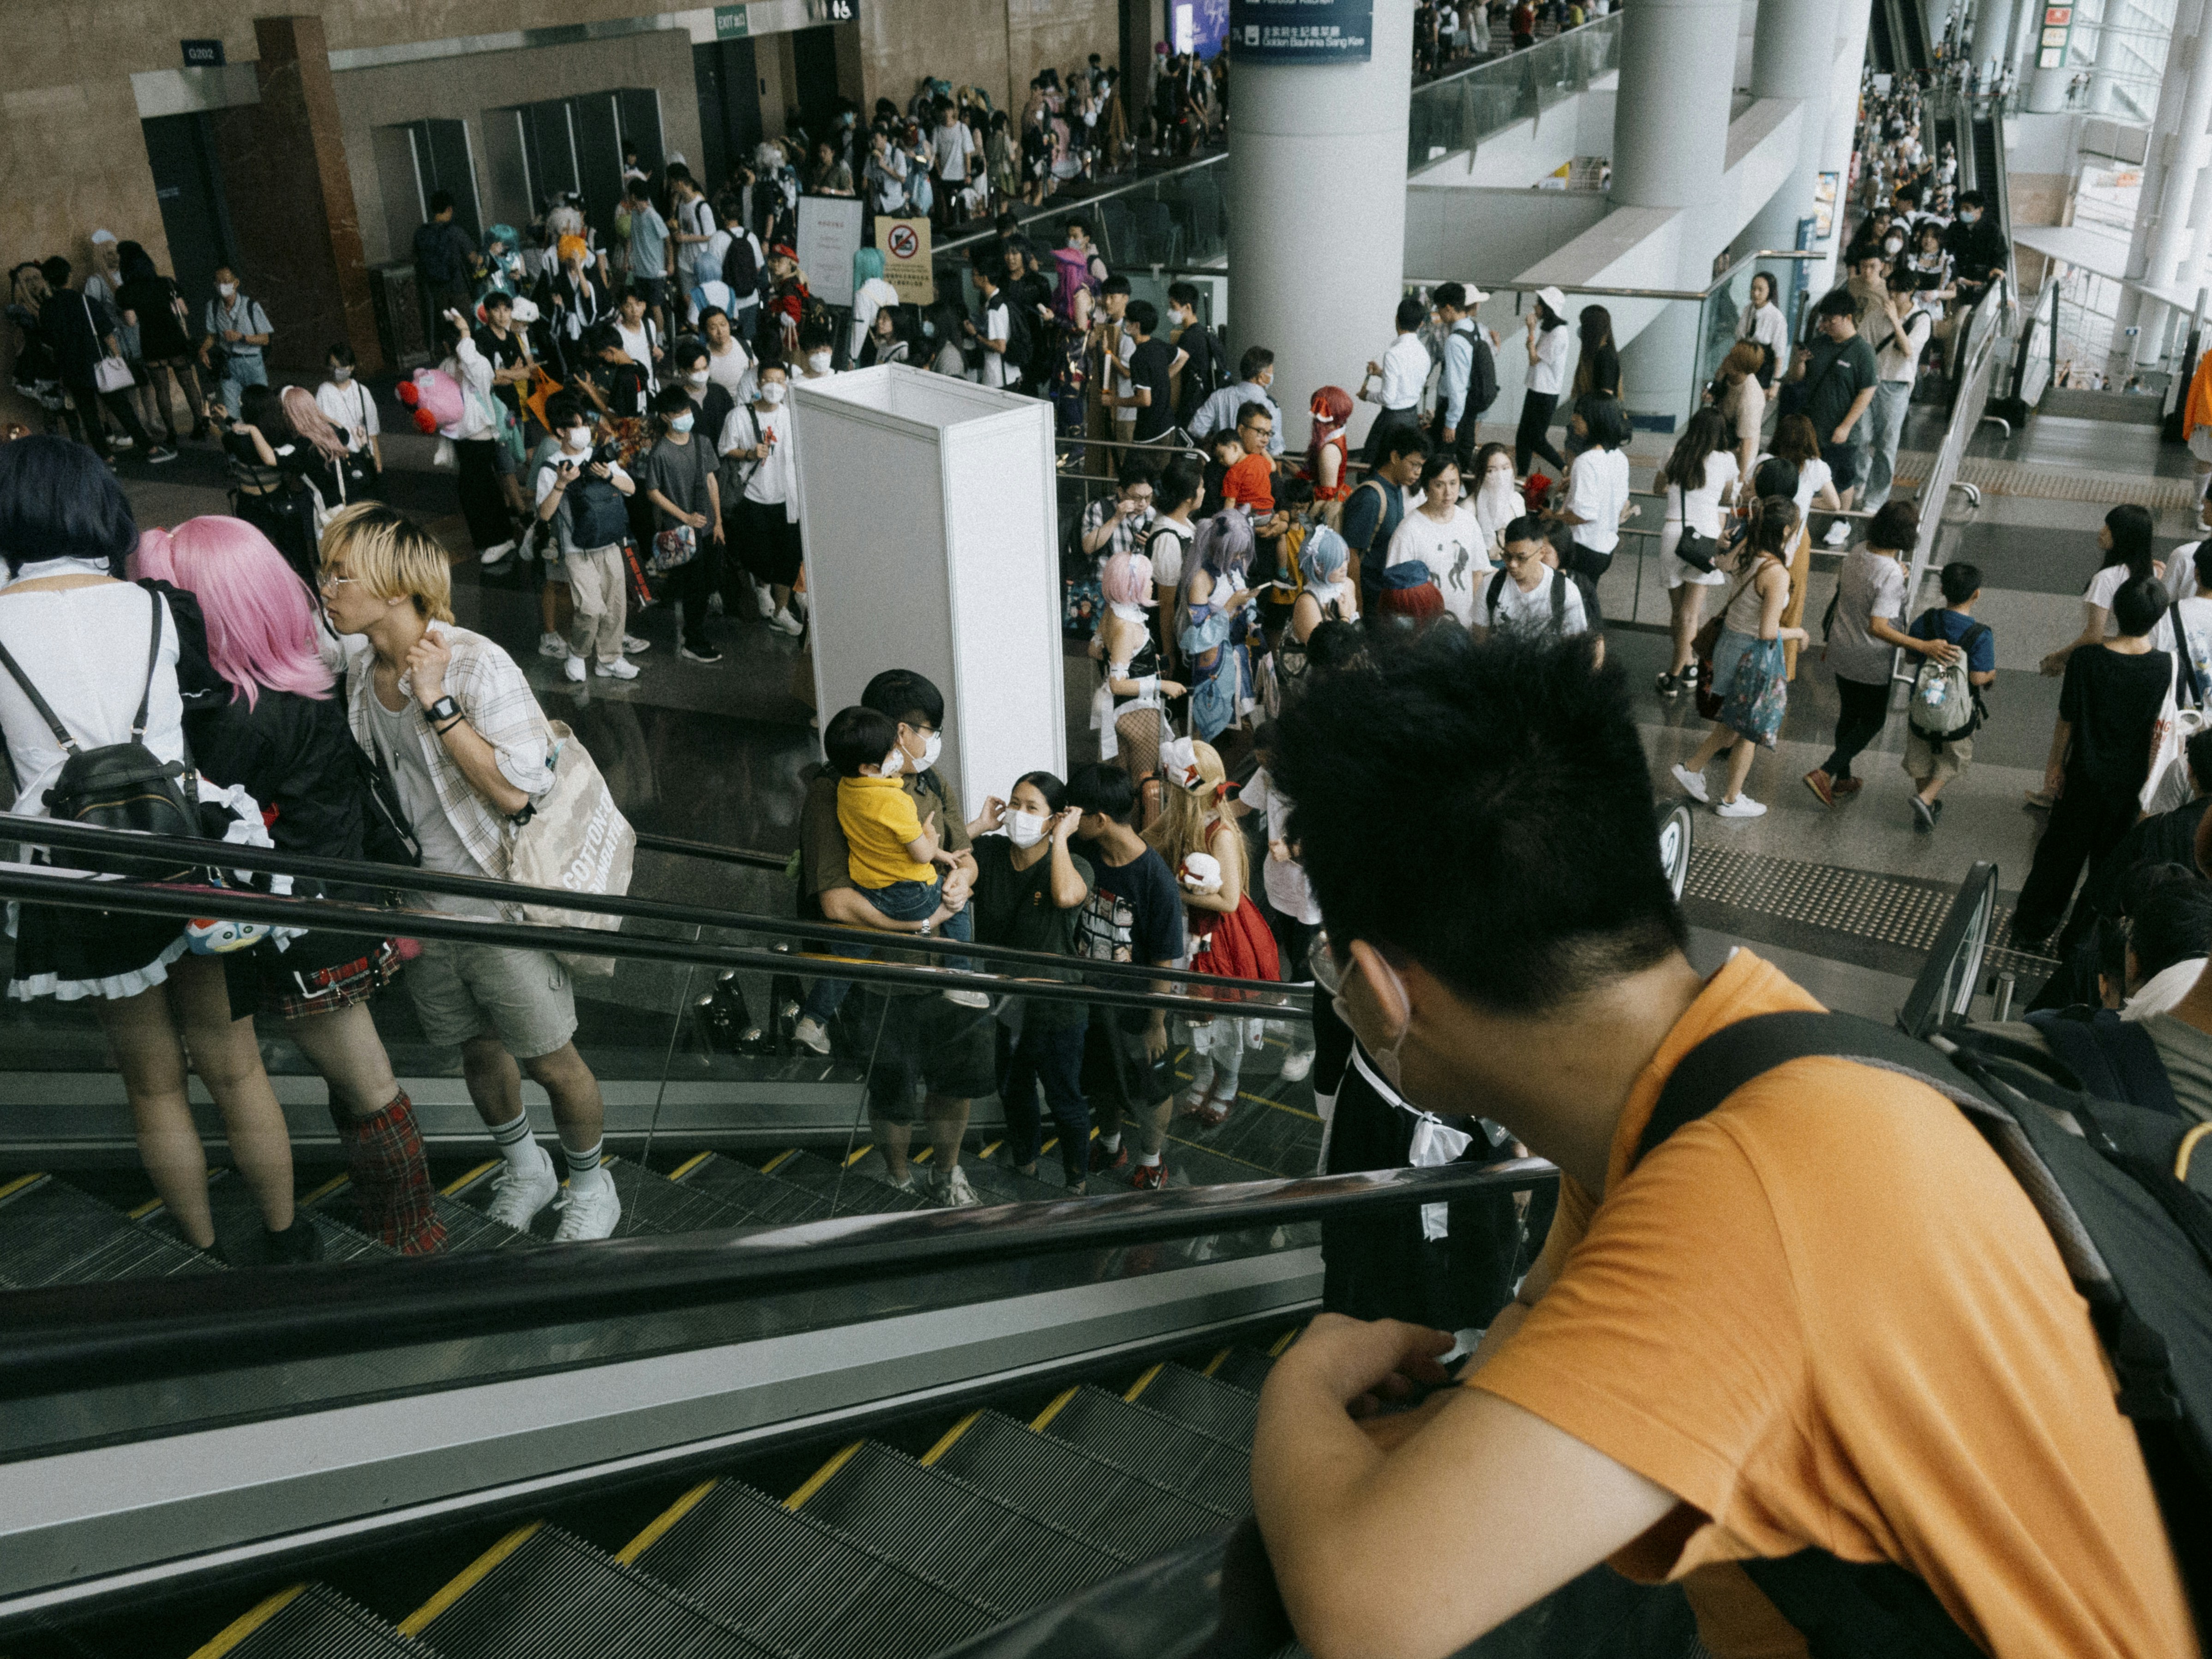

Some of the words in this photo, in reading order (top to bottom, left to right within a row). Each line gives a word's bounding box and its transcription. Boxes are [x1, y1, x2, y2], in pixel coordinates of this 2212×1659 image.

[717, 15, 732, 30] EXIT
[1262, 36, 1289, 46] Golden
[563, 785, 613, 890] COTTON:O
